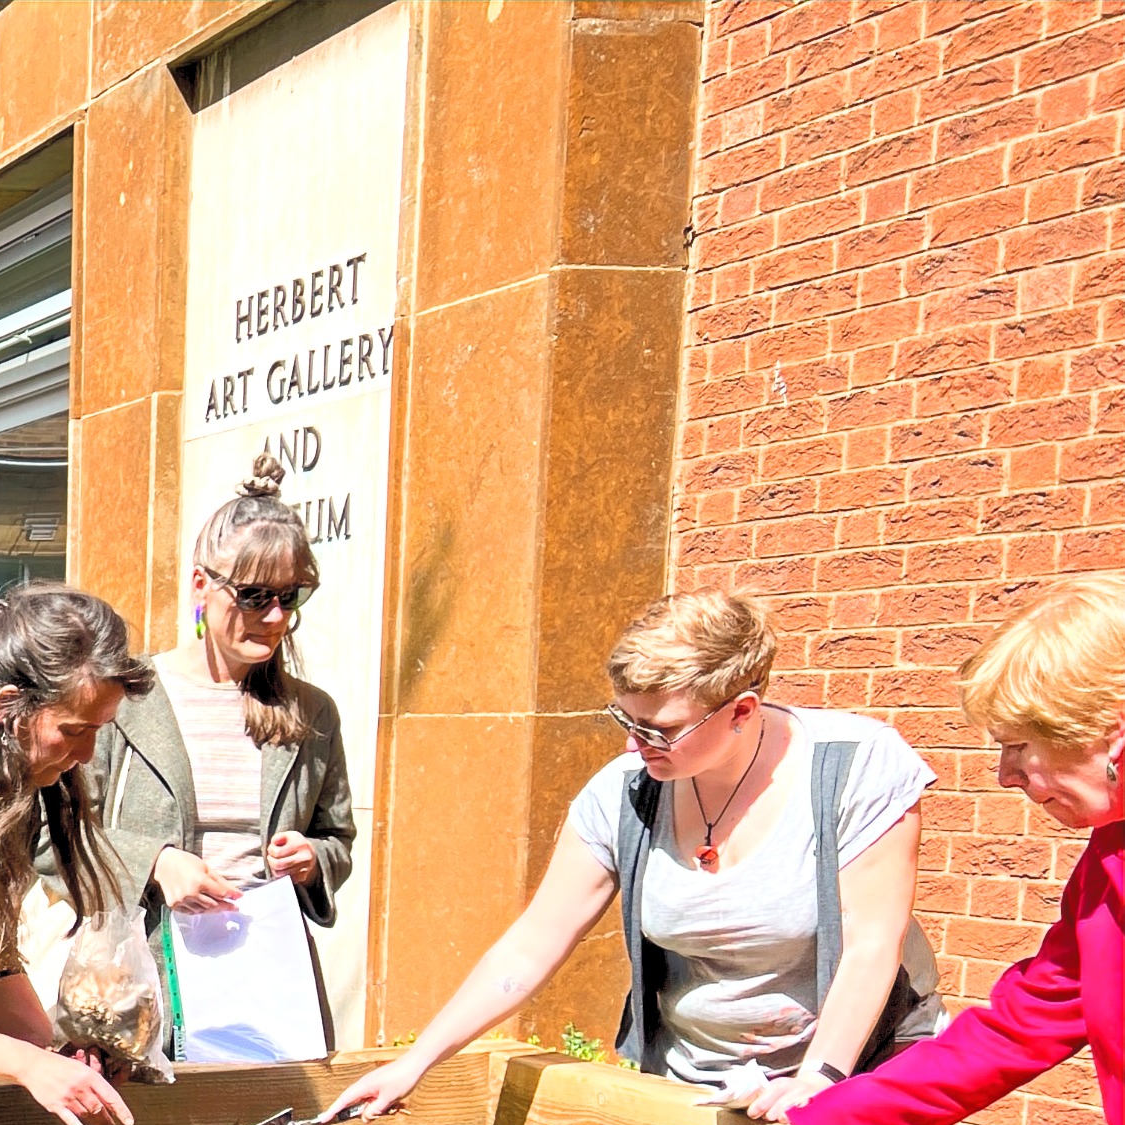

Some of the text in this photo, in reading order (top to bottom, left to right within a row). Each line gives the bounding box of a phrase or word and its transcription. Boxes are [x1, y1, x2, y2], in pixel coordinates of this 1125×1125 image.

[235, 252, 367, 343] HERBERT
[204, 325, 394, 423] ART GALLERY
